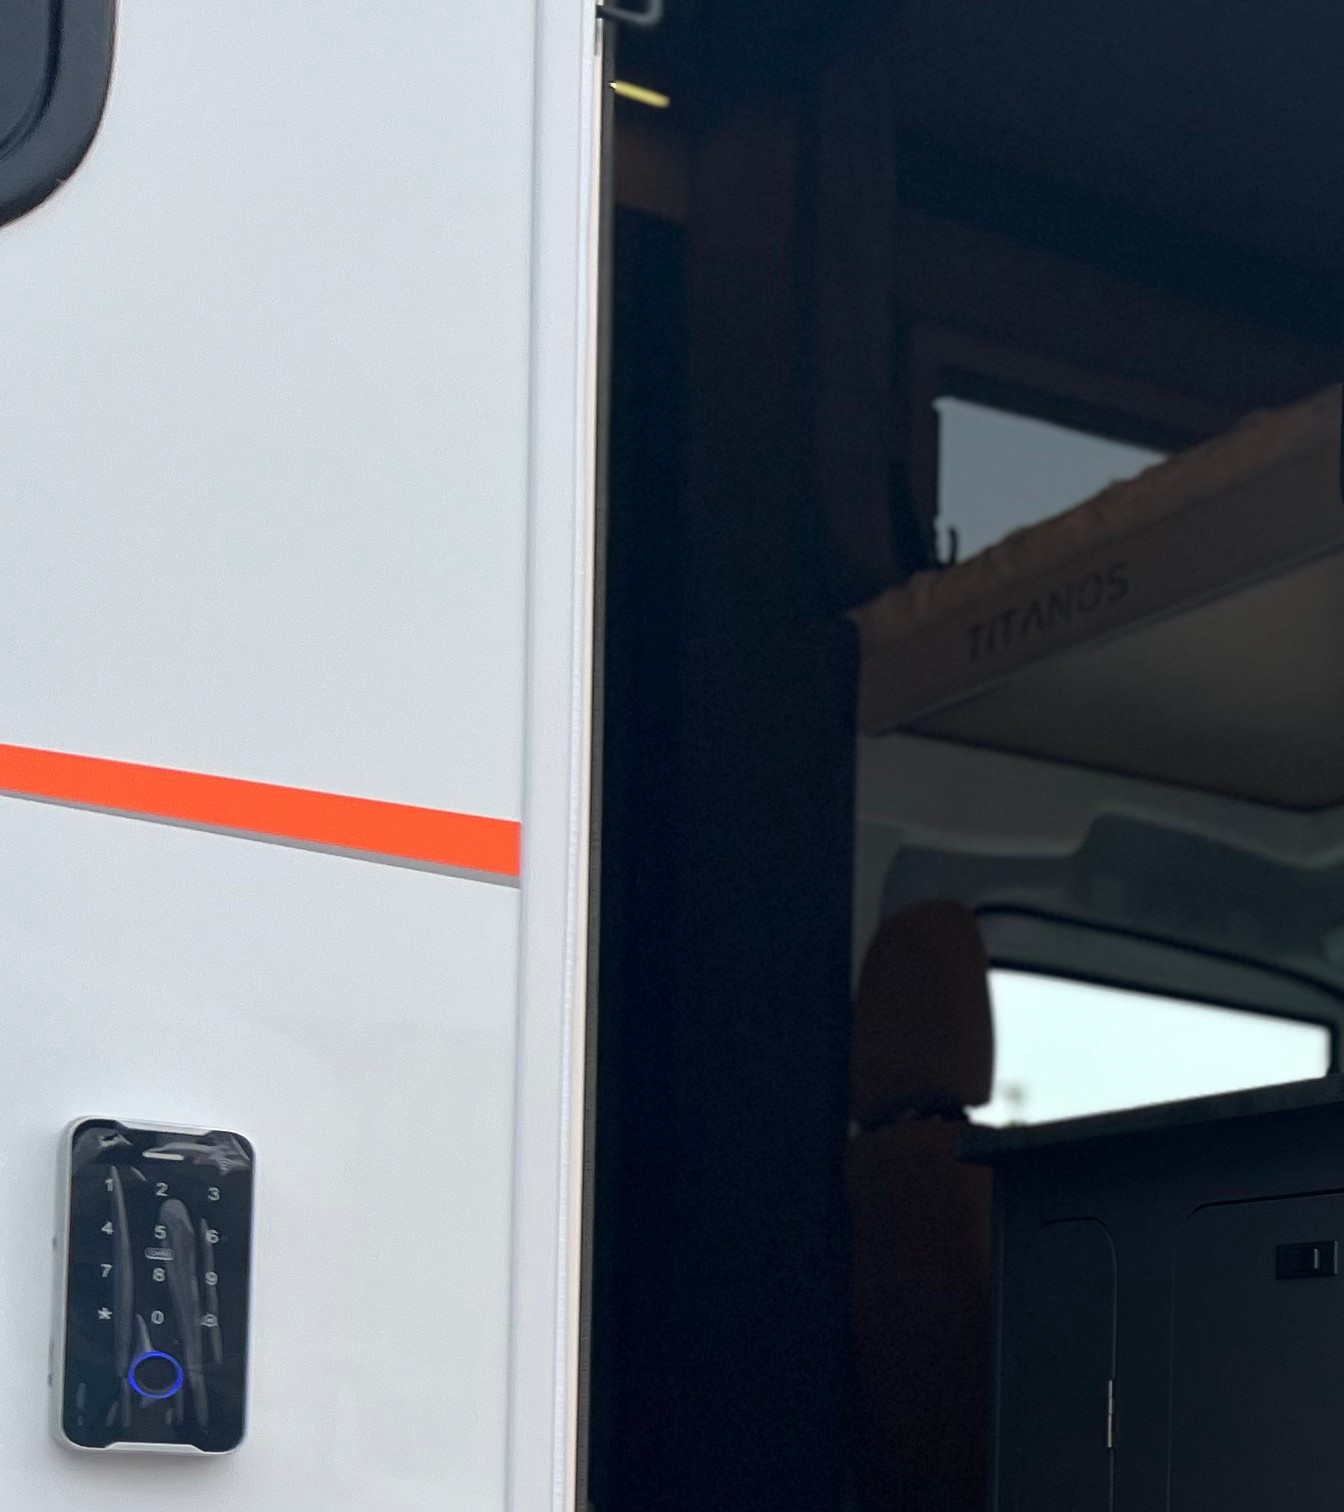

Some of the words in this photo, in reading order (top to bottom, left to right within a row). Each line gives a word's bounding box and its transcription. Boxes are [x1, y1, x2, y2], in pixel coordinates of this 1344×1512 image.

[966, 560, 1129, 662] TITANOS
[104, 1178, 113, 1192] 1
[155, 1182, 168, 1197] 2
[207, 1187, 221, 1201] 3
[101, 1221, 114, 1235] 4
[154, 1225, 167, 1239] 5
[205, 1229, 219, 1244] 6
[101, 1264, 113, 1278] 7
[152, 1268, 165, 1282] 8
[204, 1272, 218, 1286] 9
[151, 1310, 164, 1325] 0
